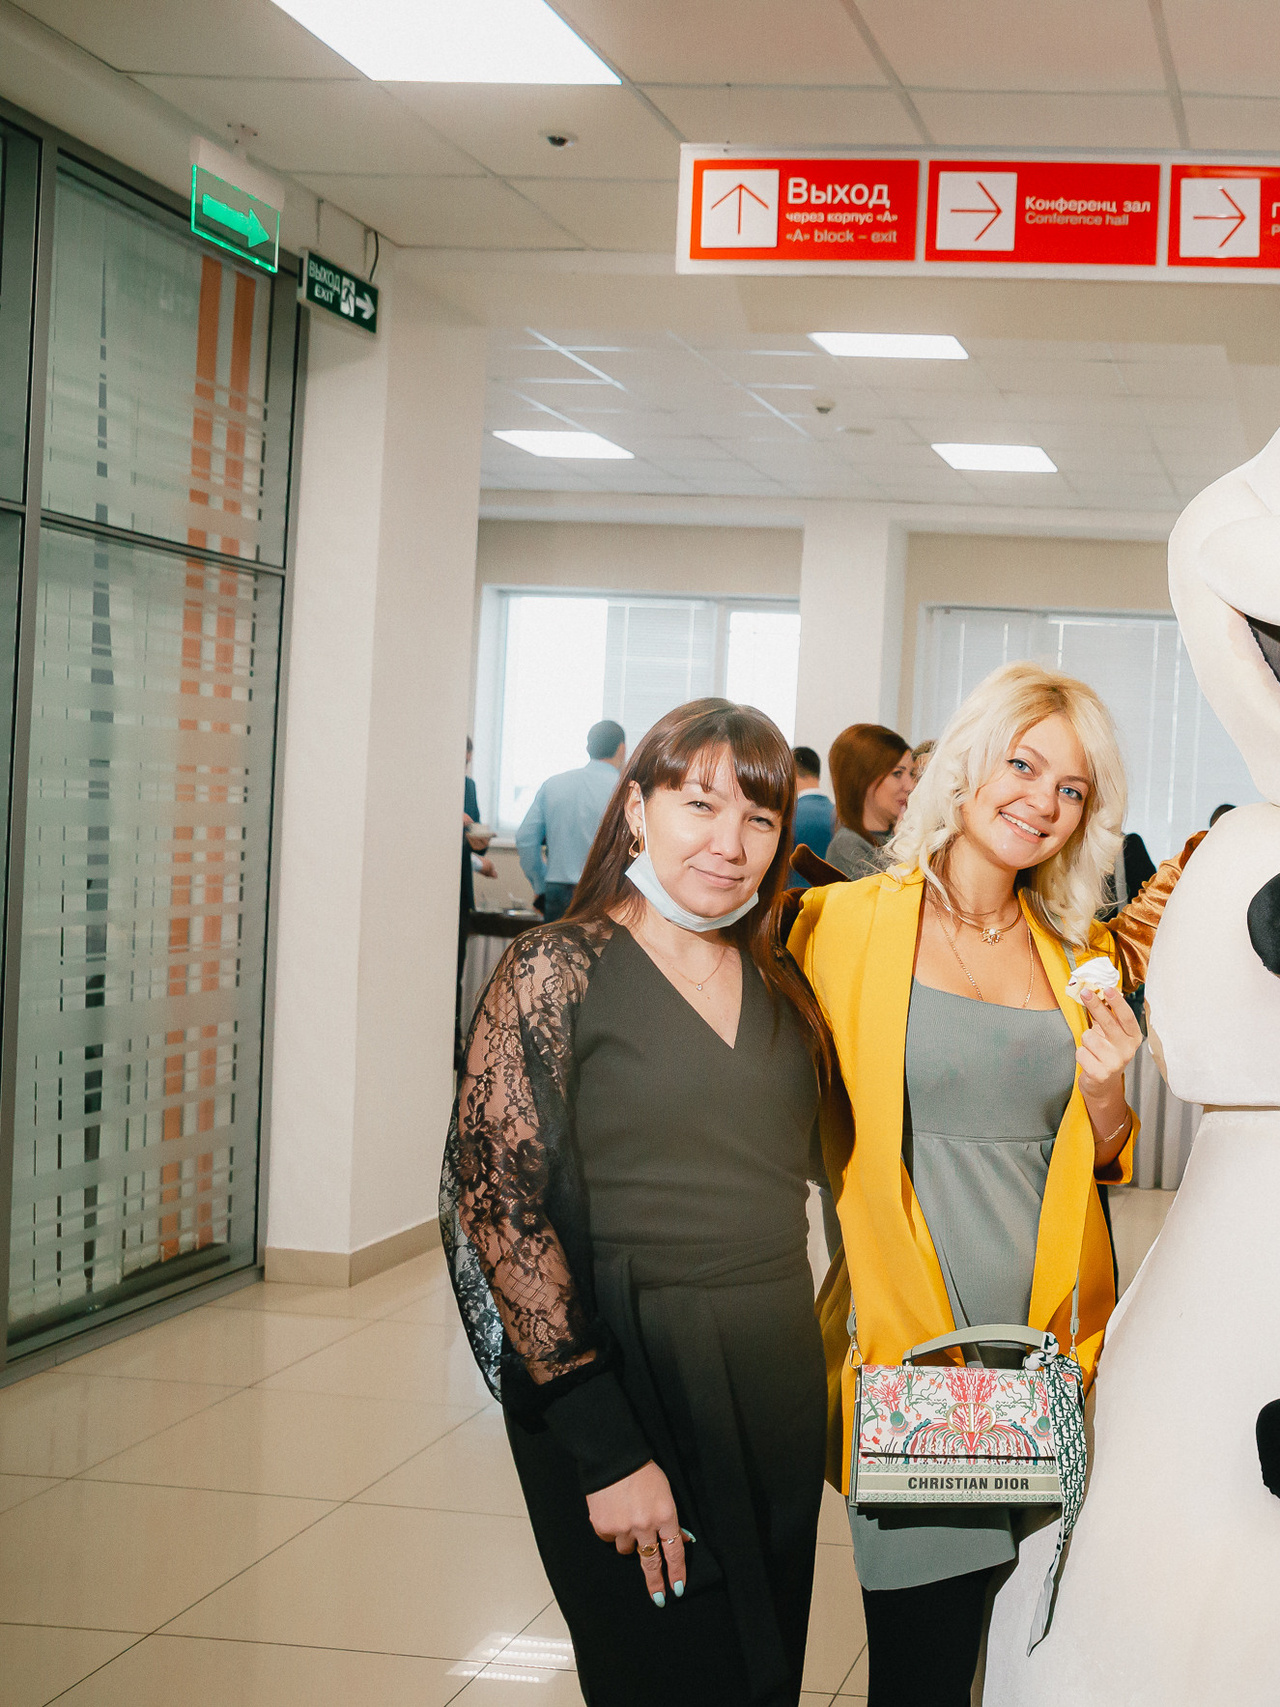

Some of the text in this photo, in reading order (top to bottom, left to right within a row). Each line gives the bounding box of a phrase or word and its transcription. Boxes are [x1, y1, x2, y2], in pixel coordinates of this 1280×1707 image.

[787, 177, 890, 209] Выход
[1025, 196, 1151, 213] Конференц зал
[785, 212, 825, 225] через
[827, 212, 874, 225] корпус
[1025, 211, 1129, 226] Conference hall
[814, 229, 854, 243] block
[871, 230, 897, 243] exit
[309, 260, 340, 295] ВЫХОД
[314, 283, 334, 304] EXIT
[908, 1477, 1029, 1490] CHRISTIAN DIOR
